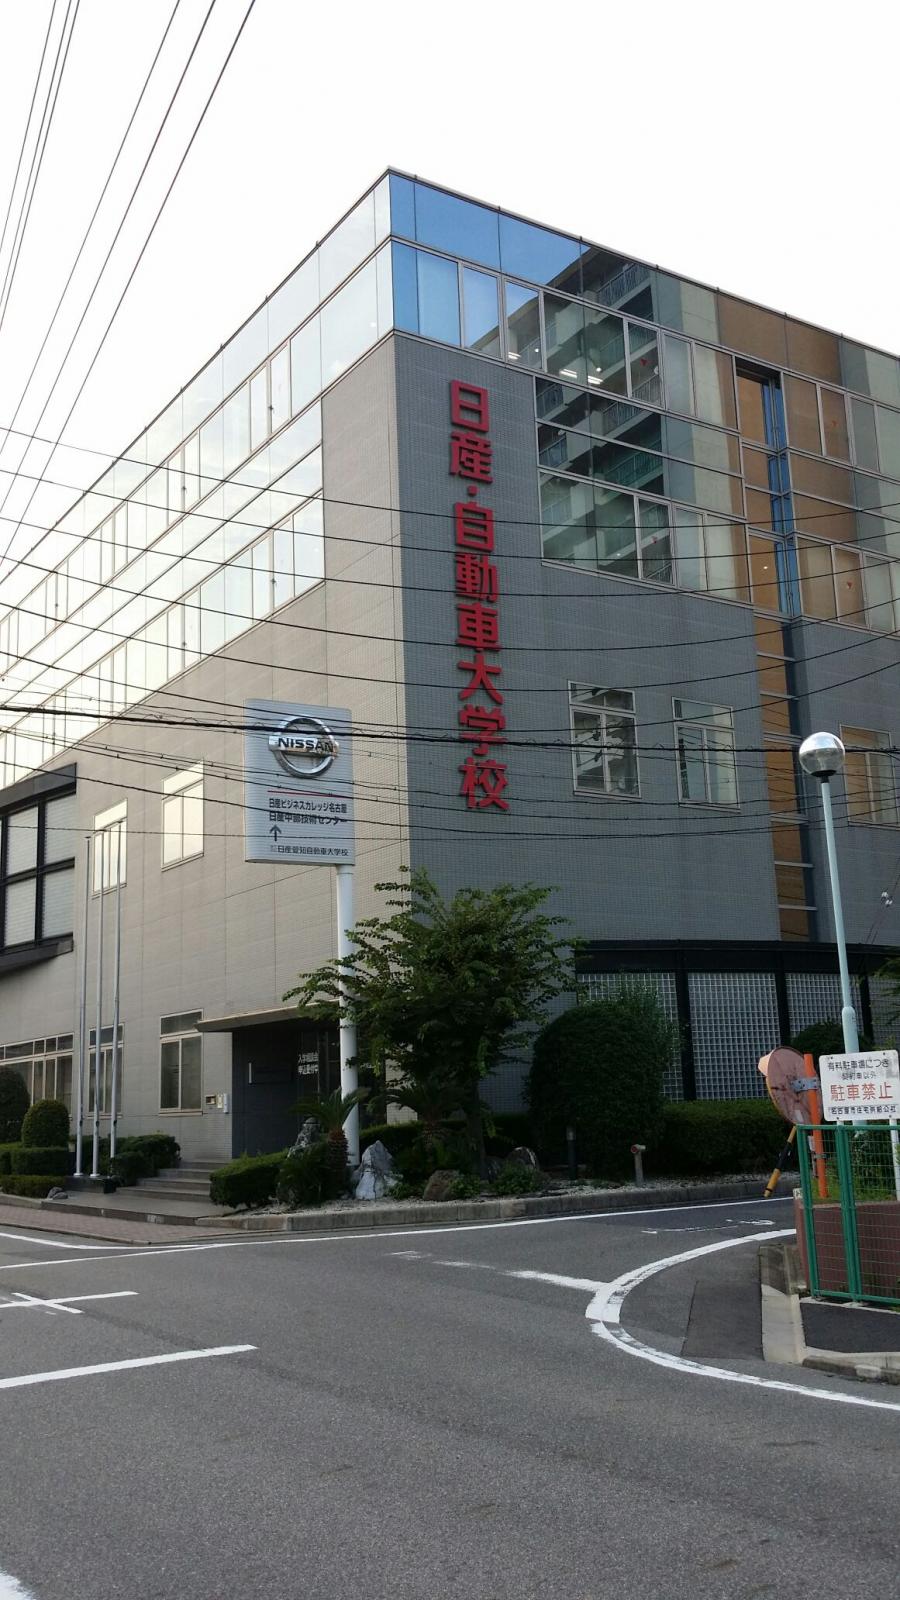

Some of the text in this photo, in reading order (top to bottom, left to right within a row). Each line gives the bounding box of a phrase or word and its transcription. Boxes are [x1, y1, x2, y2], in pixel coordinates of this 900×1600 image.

[278, 737, 334, 753] NISSAN
[269, 798, 347, 813] 日産ビジネスカレッジ名古屋
[830, 1081, 893, 1101] 駐車禁止
